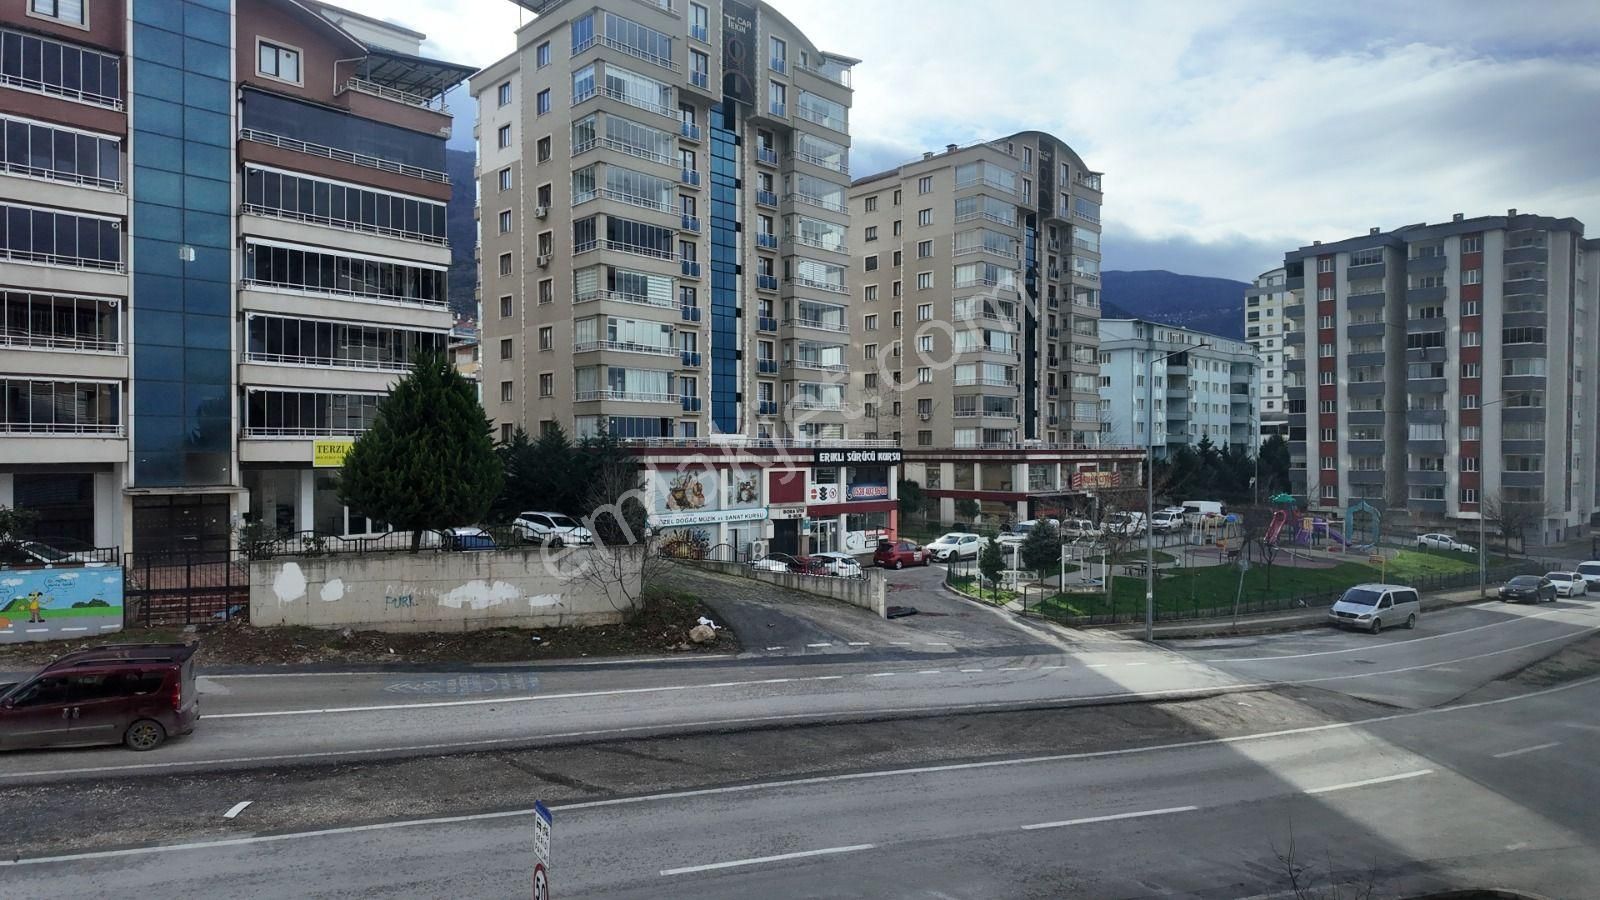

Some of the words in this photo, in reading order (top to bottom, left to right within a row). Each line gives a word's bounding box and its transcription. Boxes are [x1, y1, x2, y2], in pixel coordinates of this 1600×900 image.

[846, 450, 876, 462] SÜRÜCÜ
[877, 452, 901, 462] KURSU
[725, 513, 744, 521] SANAT
[744, 511, 764, 519] KURSU
